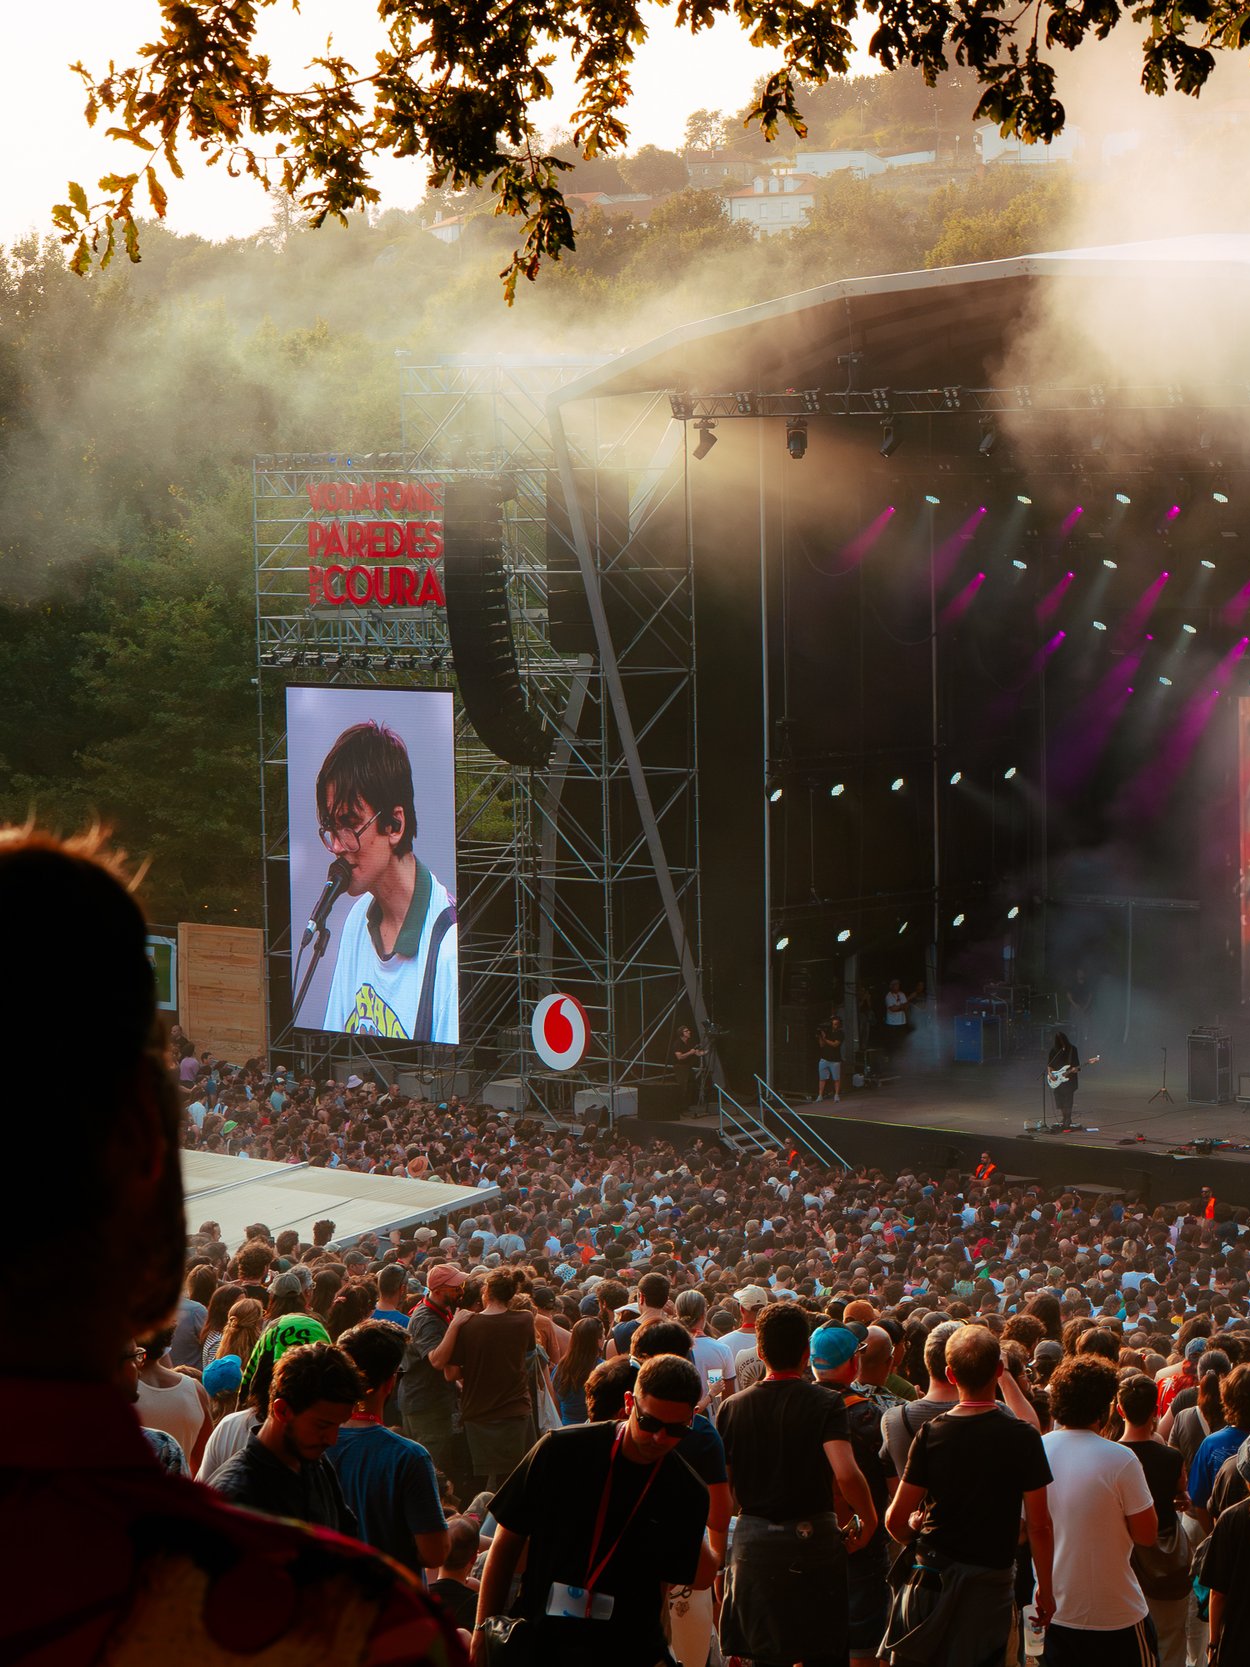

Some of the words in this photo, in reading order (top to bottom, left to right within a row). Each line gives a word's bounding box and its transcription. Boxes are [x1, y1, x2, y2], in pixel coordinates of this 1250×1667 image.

[306, 482, 444, 511] VODAFONE
[308, 520, 444, 558] PAREDES
[322, 564, 446, 606] COURA
